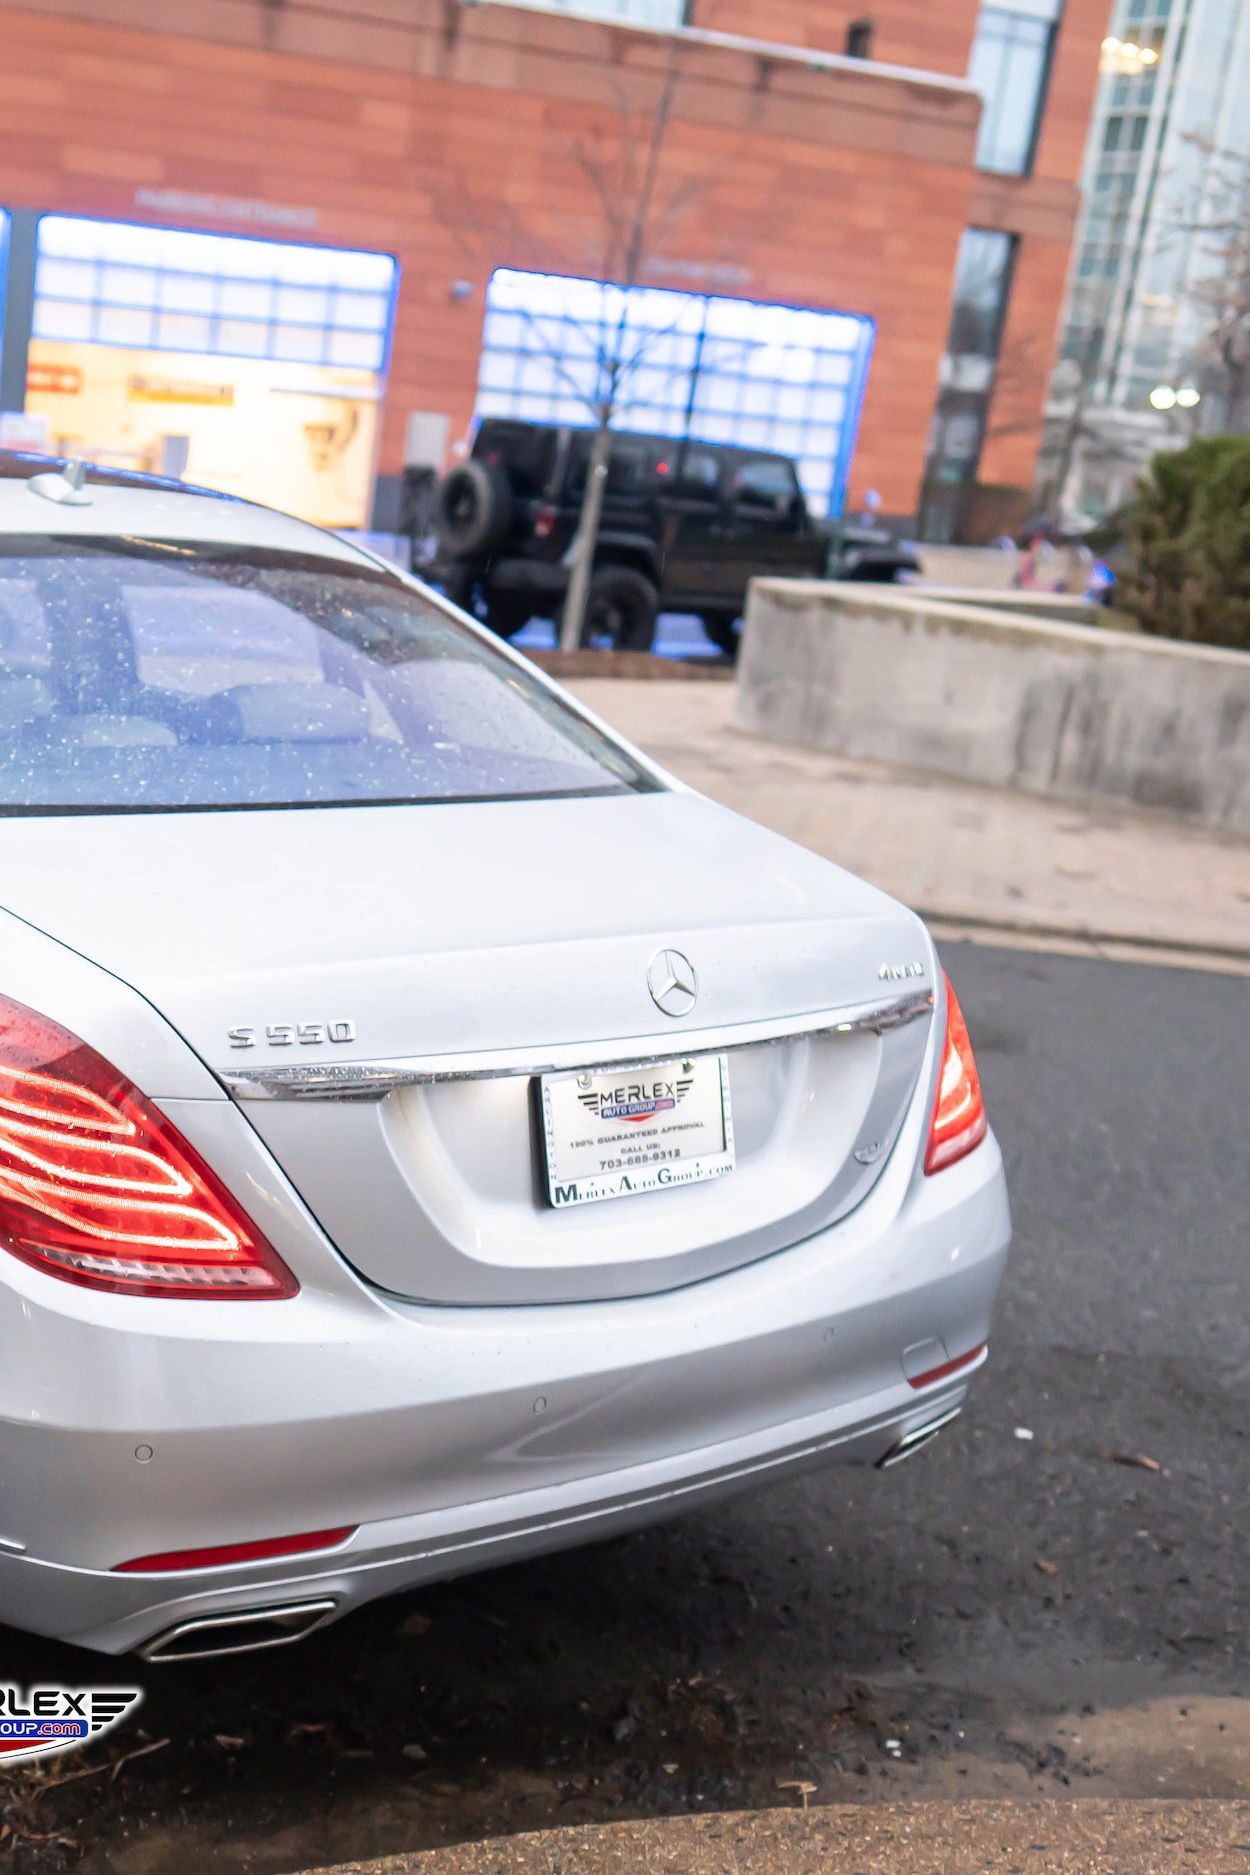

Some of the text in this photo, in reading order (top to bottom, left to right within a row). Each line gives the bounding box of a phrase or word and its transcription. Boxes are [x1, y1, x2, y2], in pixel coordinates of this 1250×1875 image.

[228, 1018, 357, 1049] S 550
[600, 1083, 675, 1105] MERLEX
[603, 1105, 627, 1118] AUTO
[597, 1130, 658, 1145] GUARANTEED
[661, 1122, 705, 1135] APPROVAL
[620, 1145, 643, 1155] CALL
